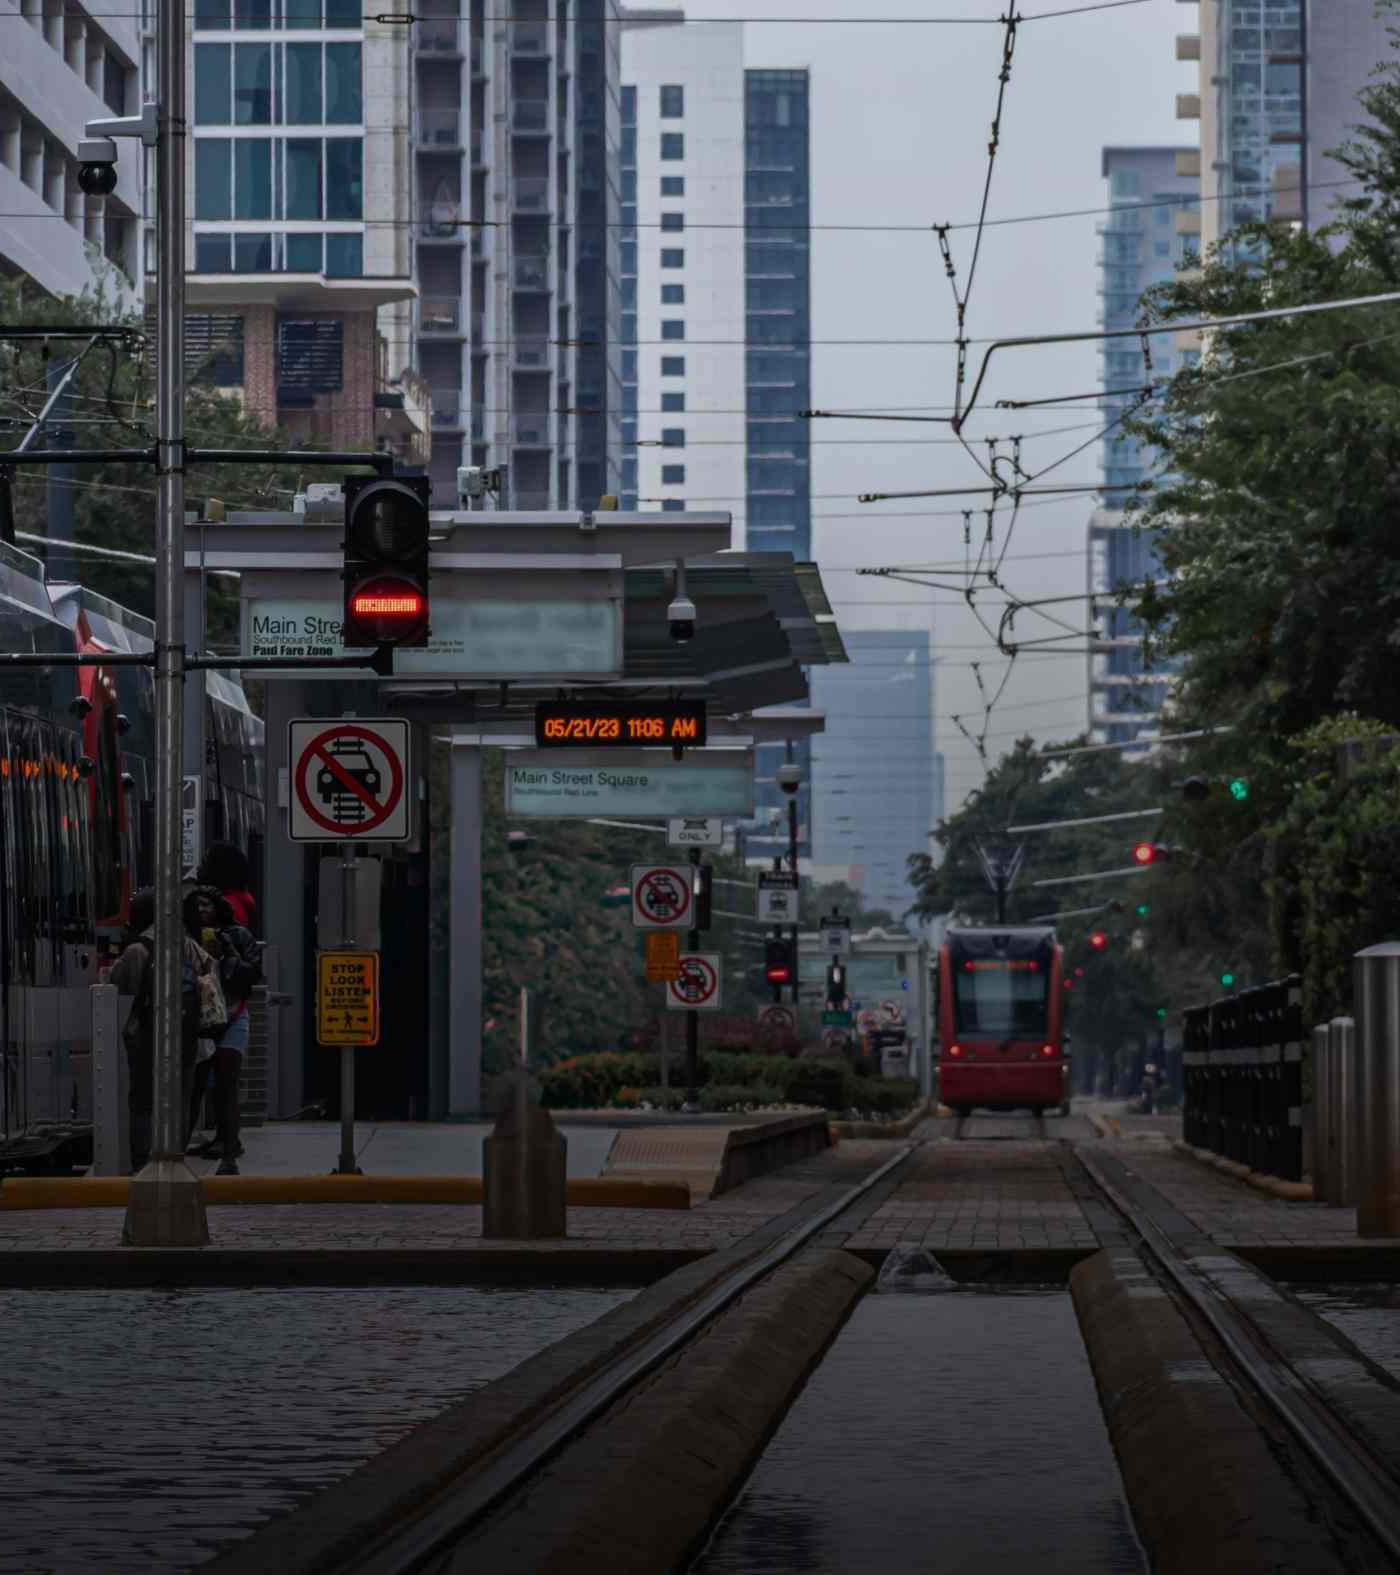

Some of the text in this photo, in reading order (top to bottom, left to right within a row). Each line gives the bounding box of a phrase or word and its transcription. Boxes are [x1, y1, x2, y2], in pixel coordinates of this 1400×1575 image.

[253, 616, 346, 635] Main Stre
[253, 635, 313, 645] Southbound
[316, 635, 336, 645] Red
[253, 646, 333, 656] Paid Fare Zone
[544, 717, 698, 738] 05/21/23 11:06 AM
[513, 771, 649, 788] Main Street Square
[679, 832, 711, 842] ONLY
[331, 964, 365, 974] STOP
[330, 976, 365, 985] LOOK
[324, 987, 371, 997] LISTEN
